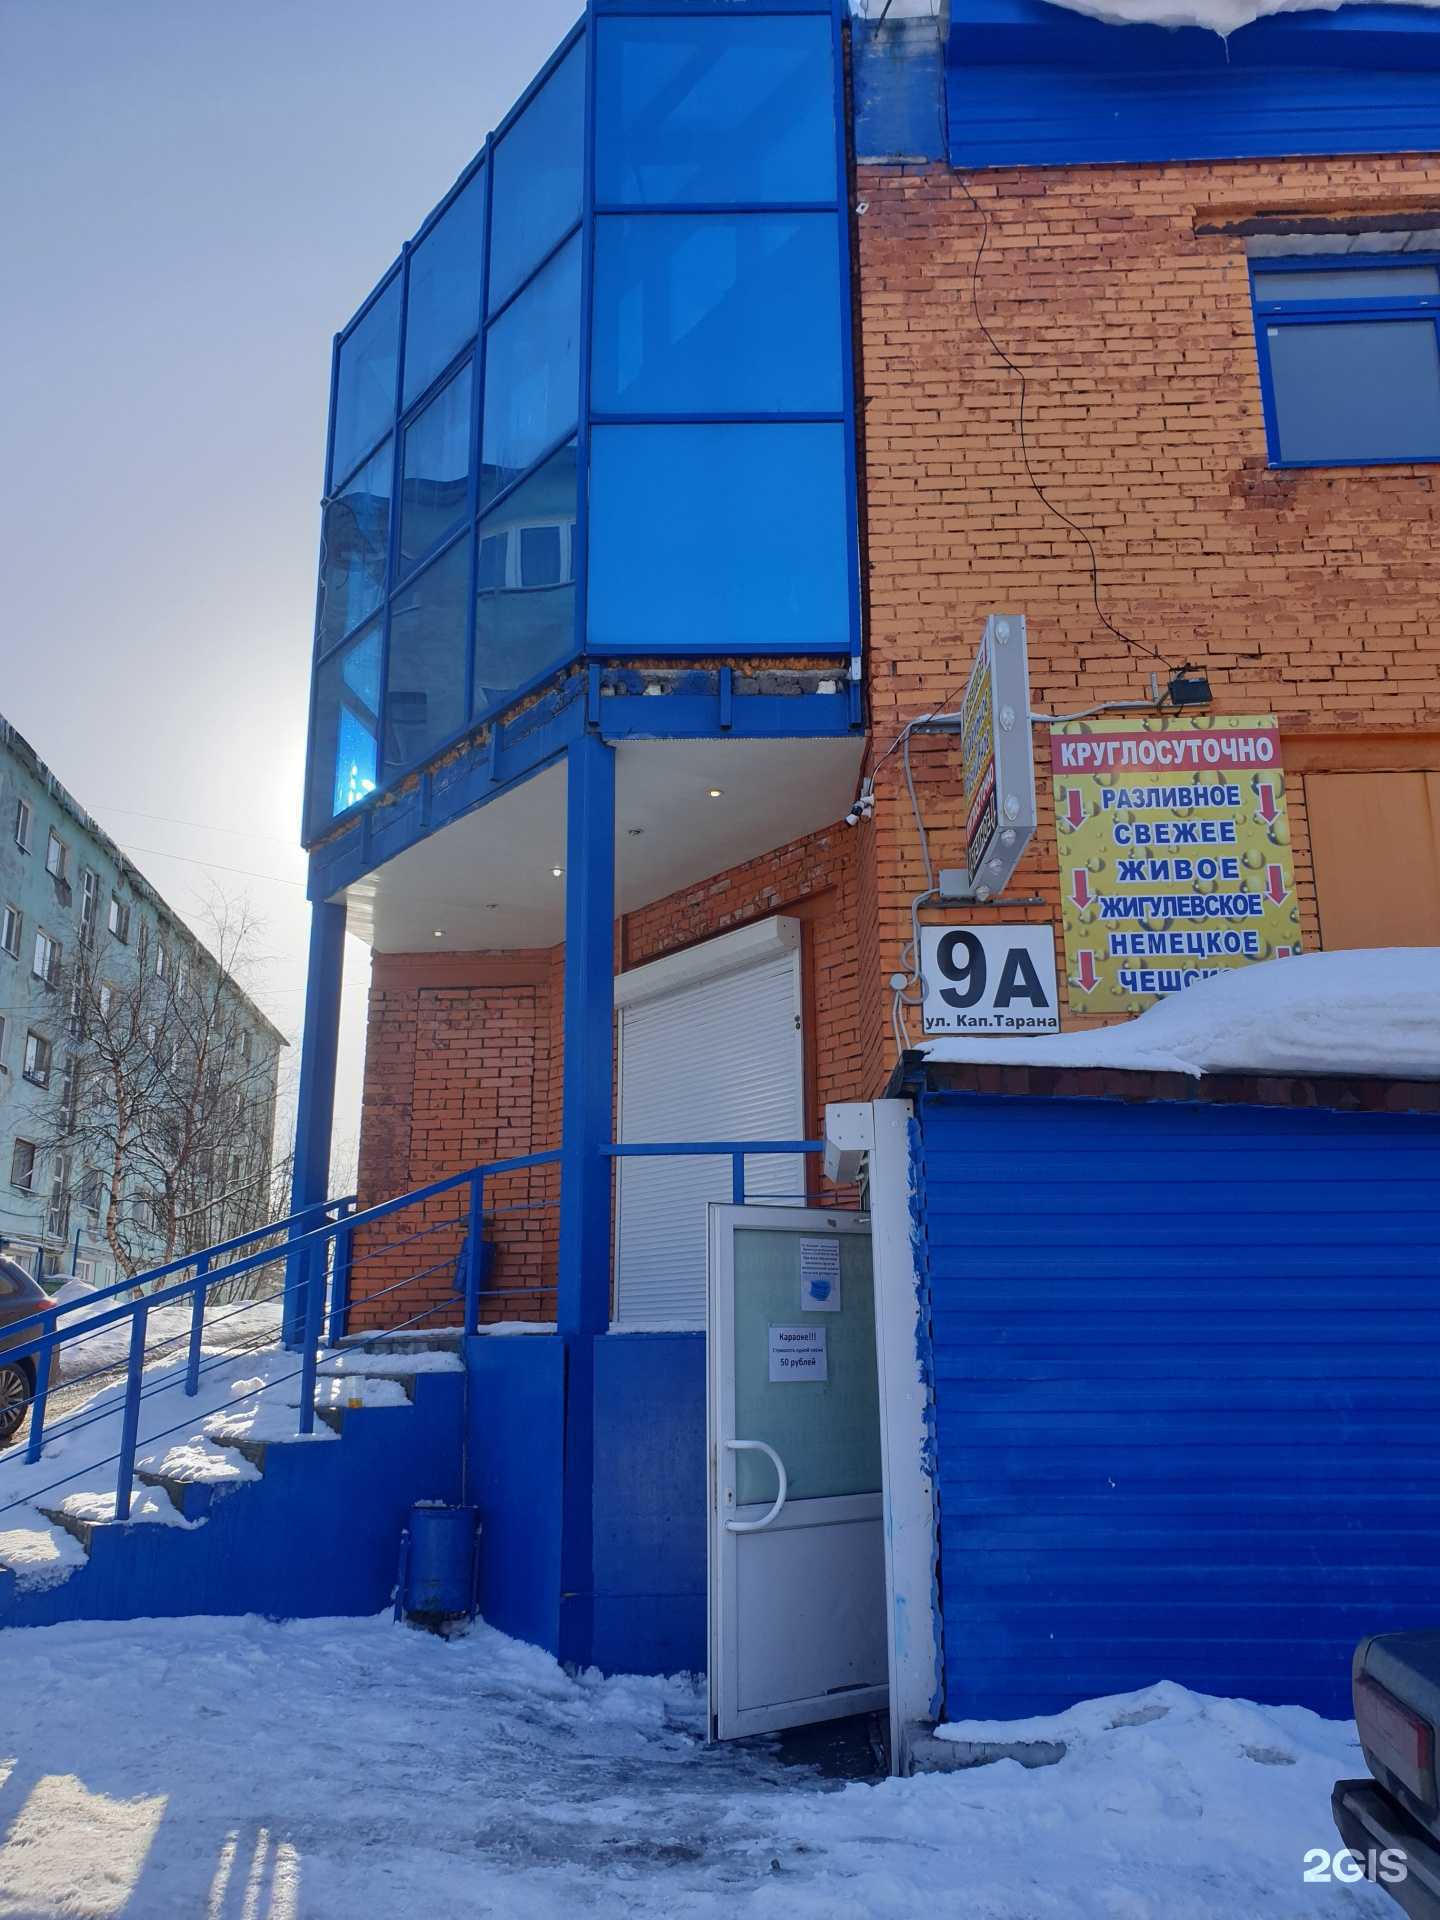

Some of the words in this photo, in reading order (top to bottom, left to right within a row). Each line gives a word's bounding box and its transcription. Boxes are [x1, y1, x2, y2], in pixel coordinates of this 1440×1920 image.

[1060, 736, 1274, 767] КРУГЛОСУТОЧНО
[1102, 784, 1241, 809] РАЗЛИВНОЕ
[1114, 821, 1236, 845] СВЕЖЕЕ
[1118, 858, 1240, 881] ЖИВОЕ
[1101, 893, 1263, 918] ЖИГУЛЕВСКОЕ
[1110, 930, 1259, 958] НЕМЕЦКОЕ
[936, 930, 1050, 1009] 9А
[926, 1017, 950, 1030] ул.
[779, 1332, 816, 1342] Караоке!!!
[780, 1358, 789, 1367] 50
[790, 1357, 817, 1369] рублей
